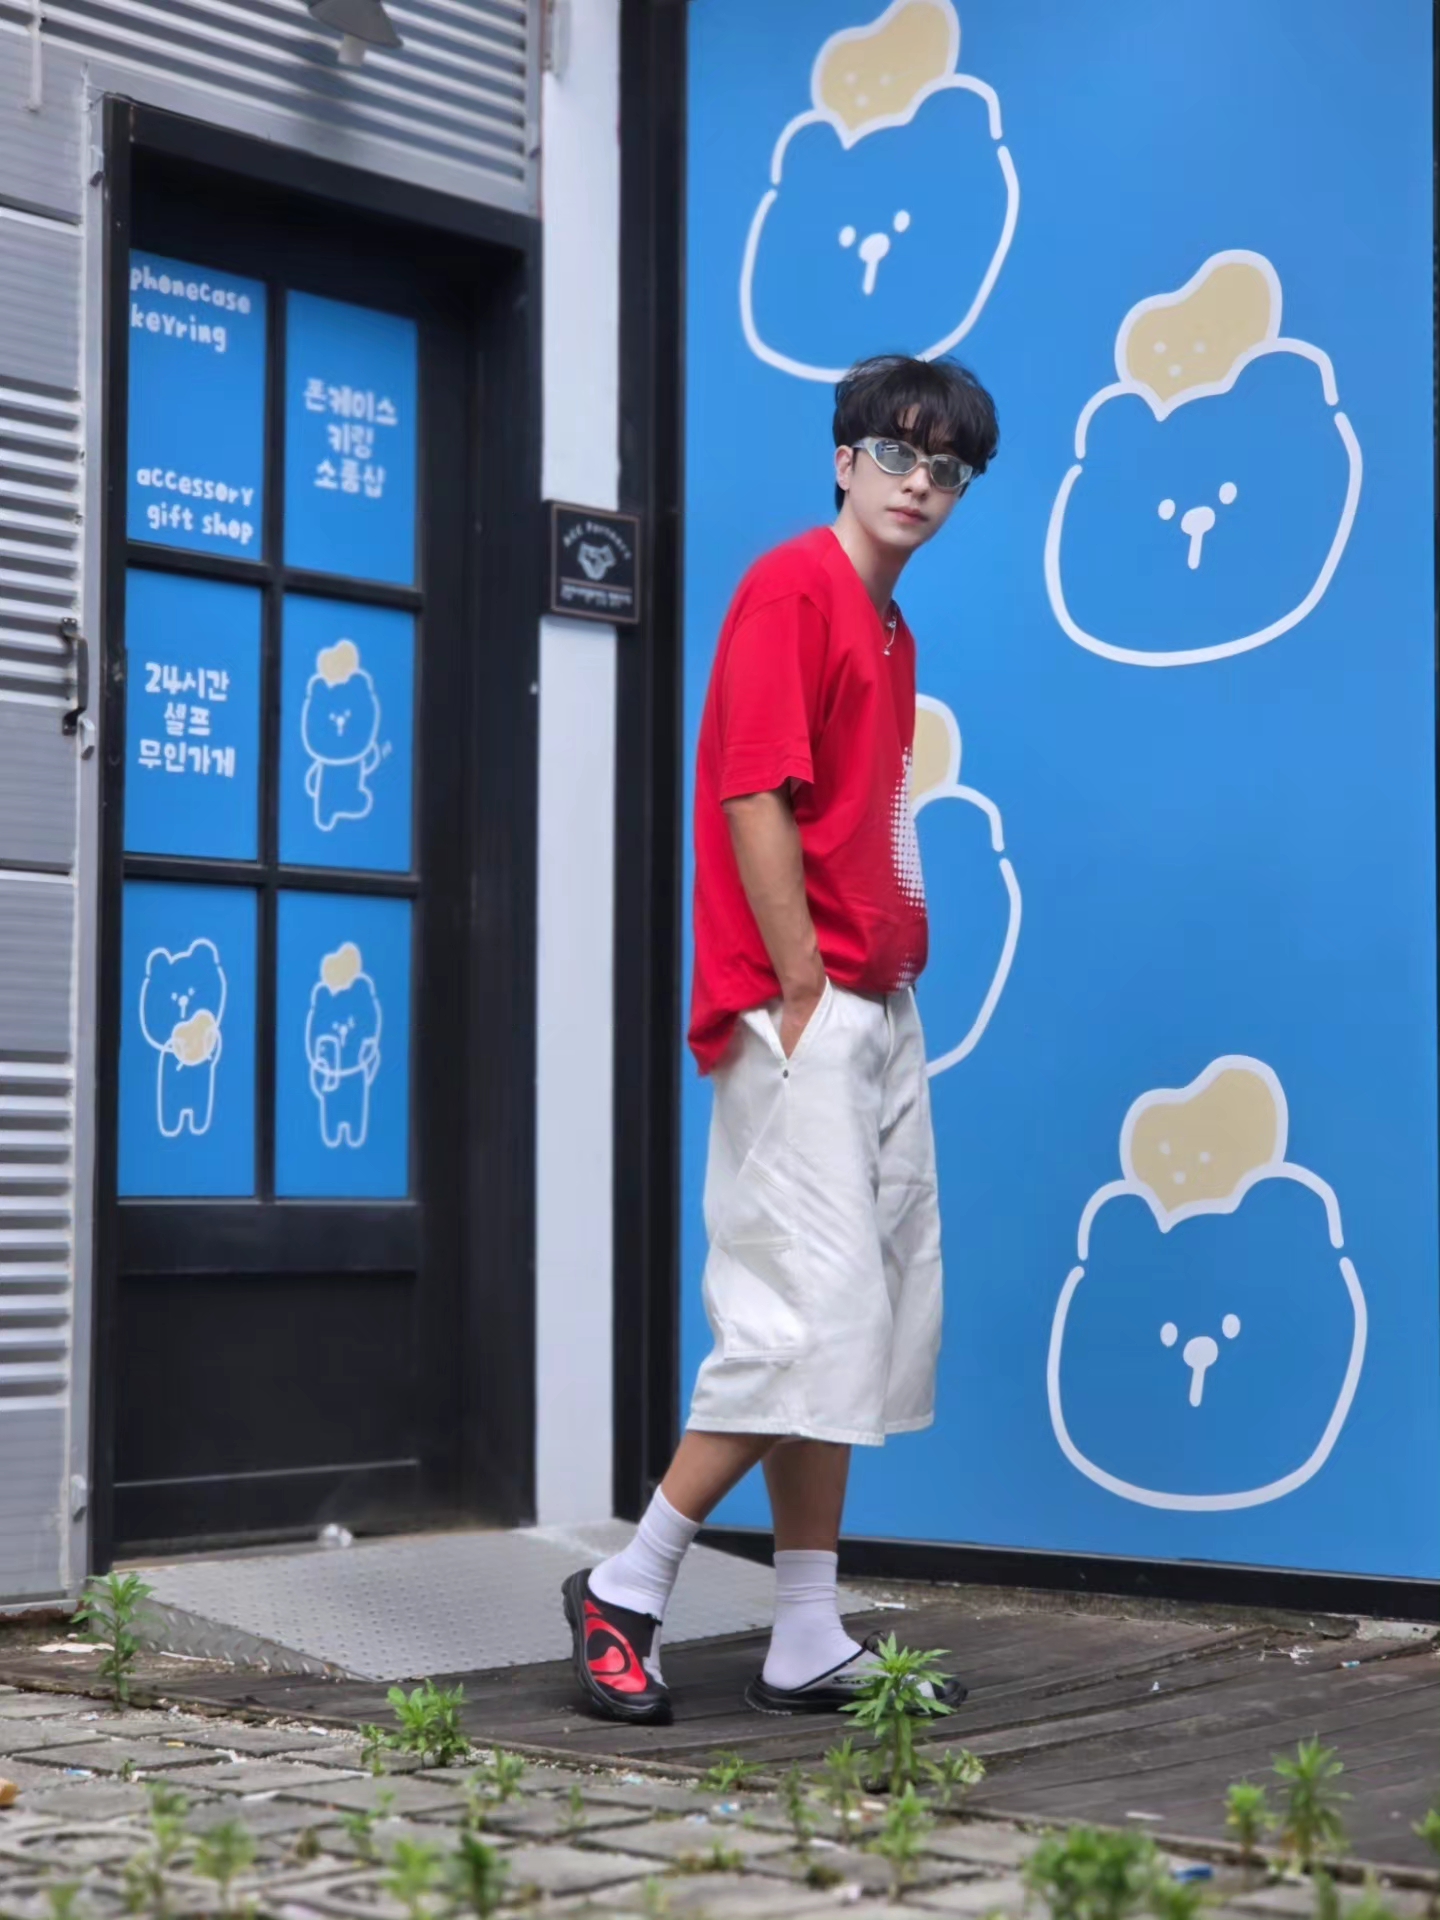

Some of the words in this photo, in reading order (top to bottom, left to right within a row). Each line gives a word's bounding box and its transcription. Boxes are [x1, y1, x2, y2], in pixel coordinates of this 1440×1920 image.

[304, 379, 397, 426] 폰케이스
[328, 423, 374, 459] 키링
[146, 502, 194, 531] gift
[201, 511, 254, 545] shop
[145, 662, 230, 702] 24시간
[164, 702, 211, 737] 셀프
[138, 739, 236, 778] 무인가게
